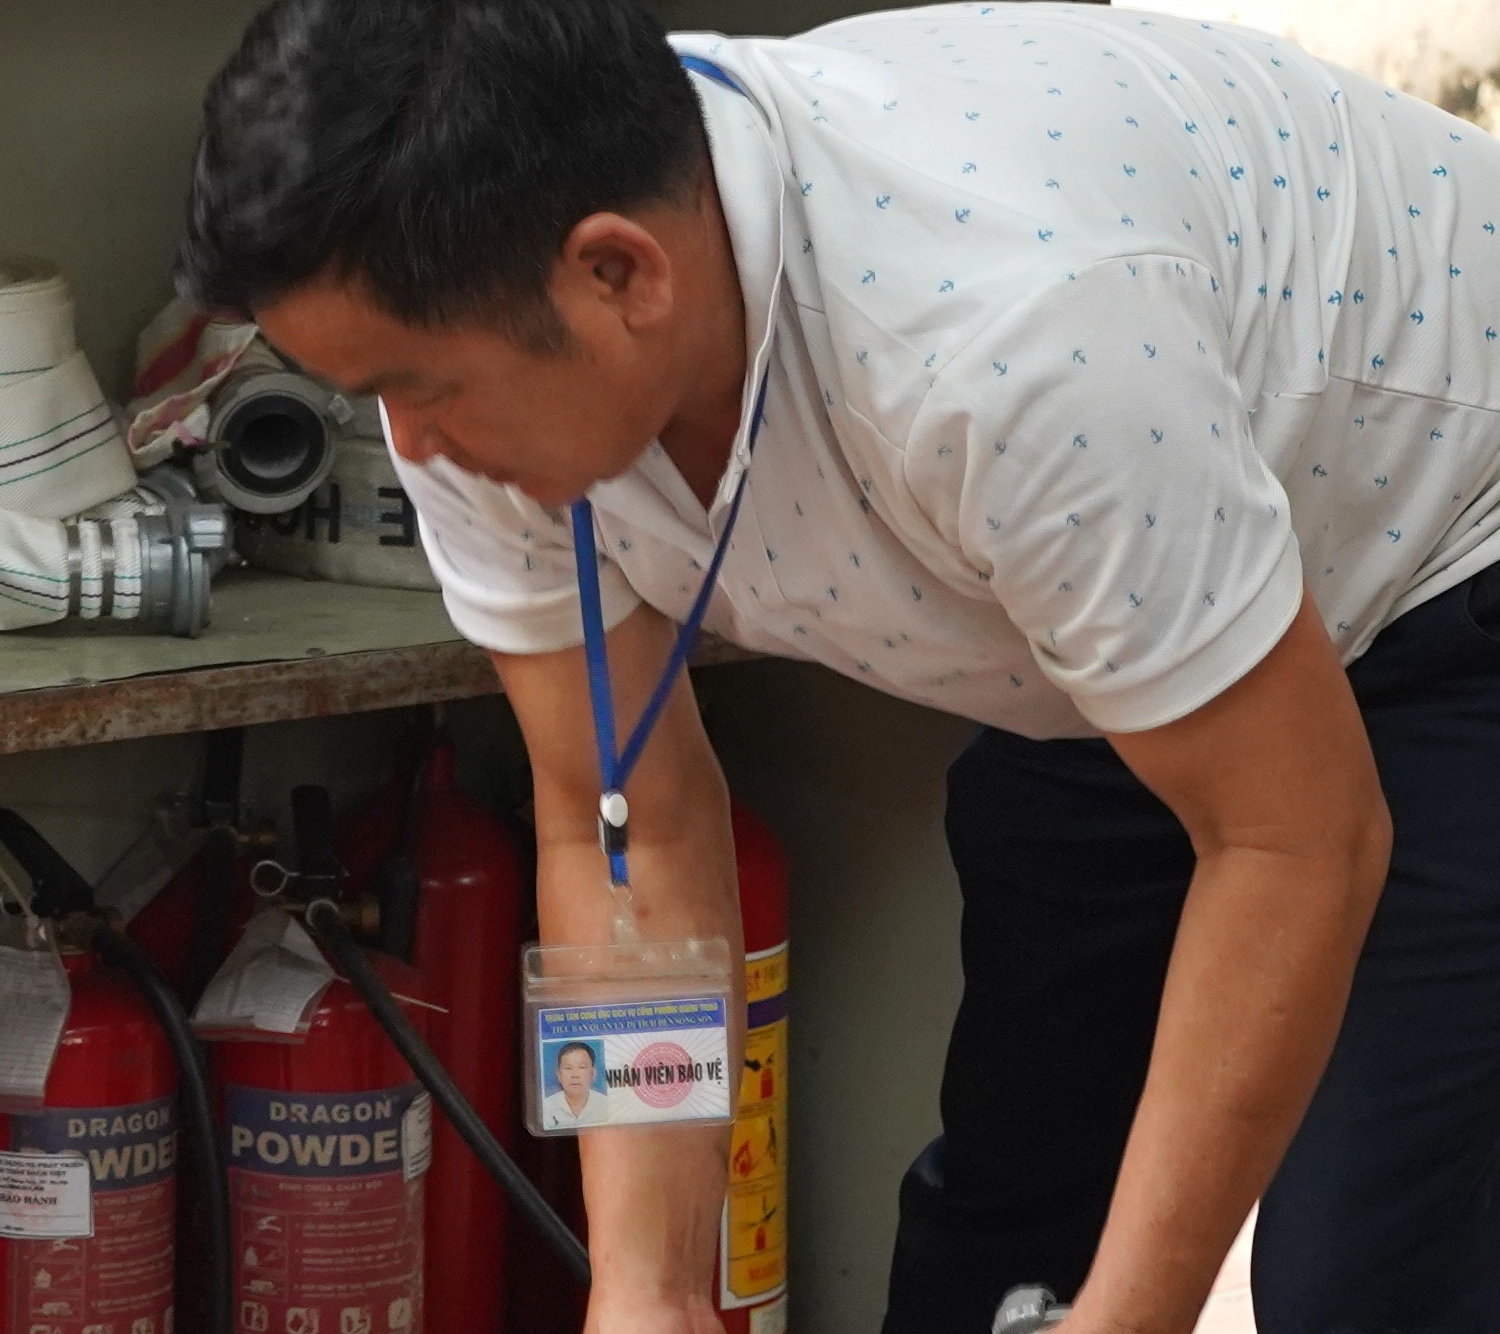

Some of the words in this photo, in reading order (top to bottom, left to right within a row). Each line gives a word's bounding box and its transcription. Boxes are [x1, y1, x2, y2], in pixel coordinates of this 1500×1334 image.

[605, 1064, 641, 1088] NHÂN
[644, 1062, 675, 1086] VIÊN
[677, 1056, 703, 1083] BẢO
[706, 1057, 723, 1085] VỆ
[67, 1106, 171, 1138] DRAGON
[269, 1100, 392, 1124] DRAGON
[231, 1125, 398, 1167] POWDE
